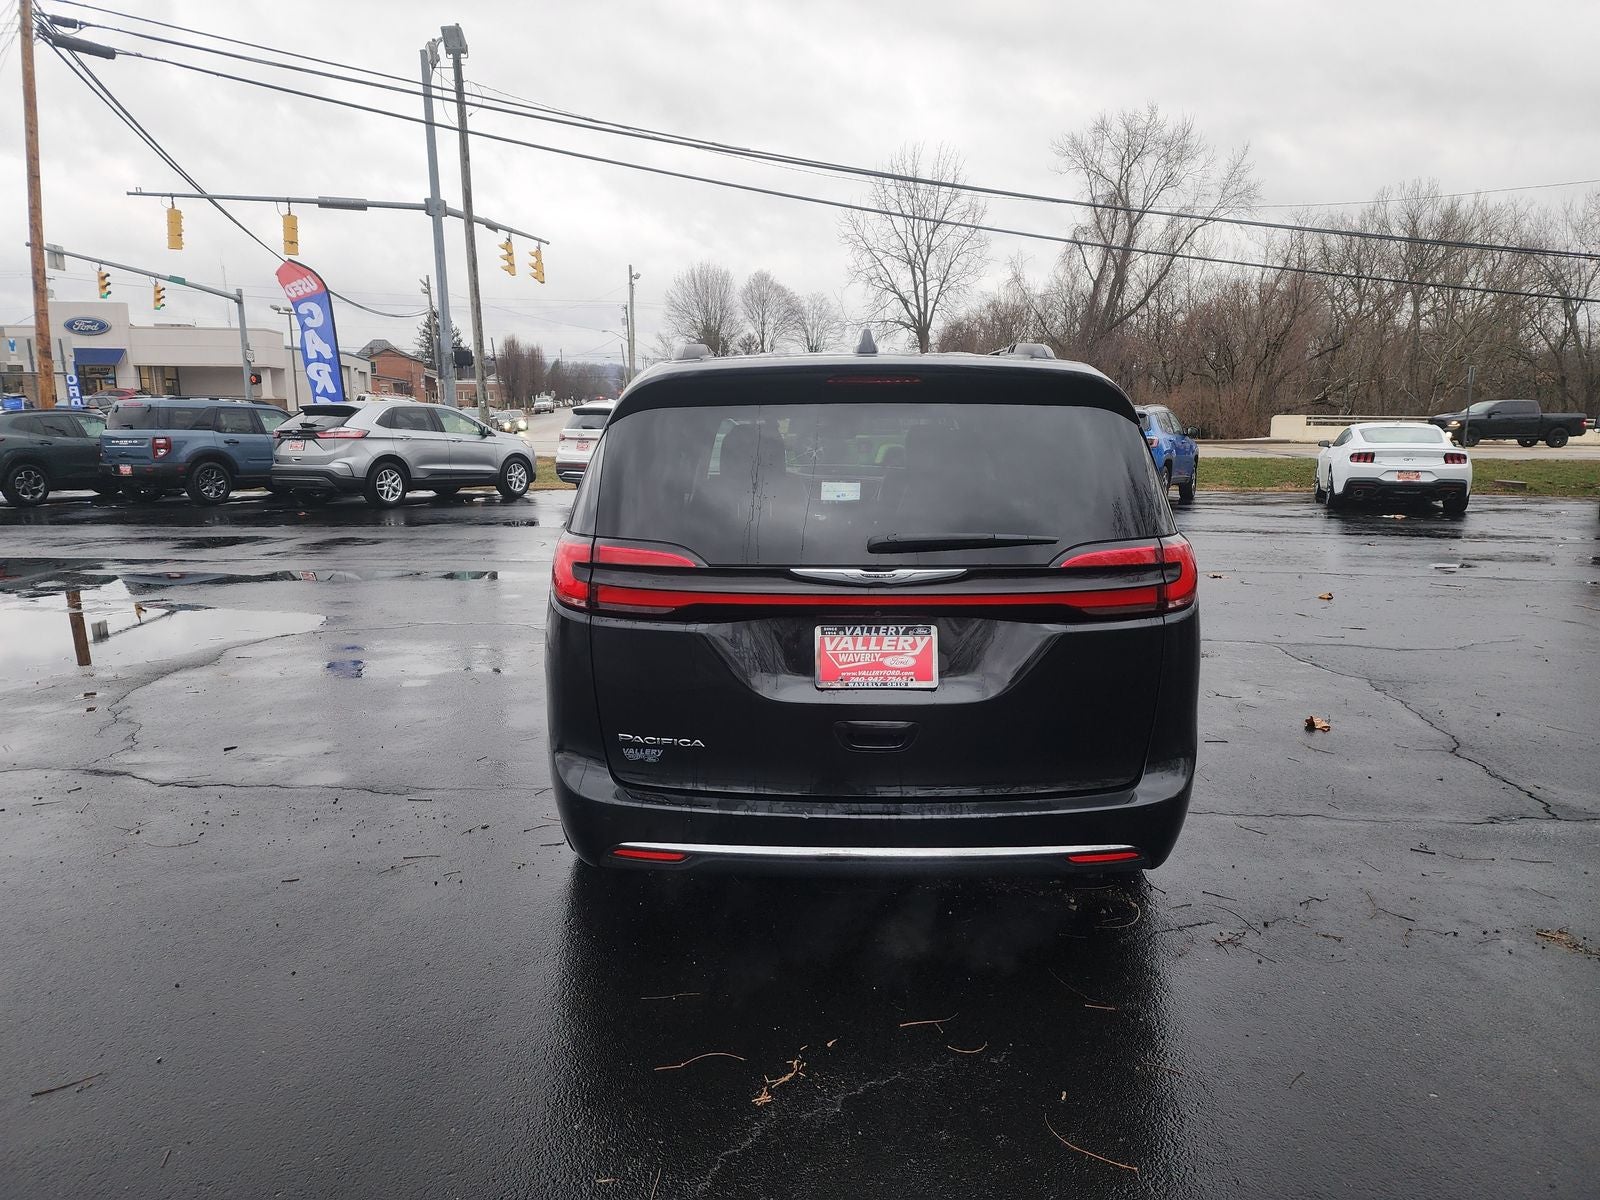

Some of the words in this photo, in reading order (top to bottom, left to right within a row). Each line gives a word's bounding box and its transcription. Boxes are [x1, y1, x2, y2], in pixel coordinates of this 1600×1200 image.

[845, 626, 906, 636] VALLERY
[824, 636, 931, 652] VALLERY
[838, 653, 881, 662] WAVERLY
[617, 733, 706, 748] PACIFICA
[622, 747, 664, 757] VALLERY
